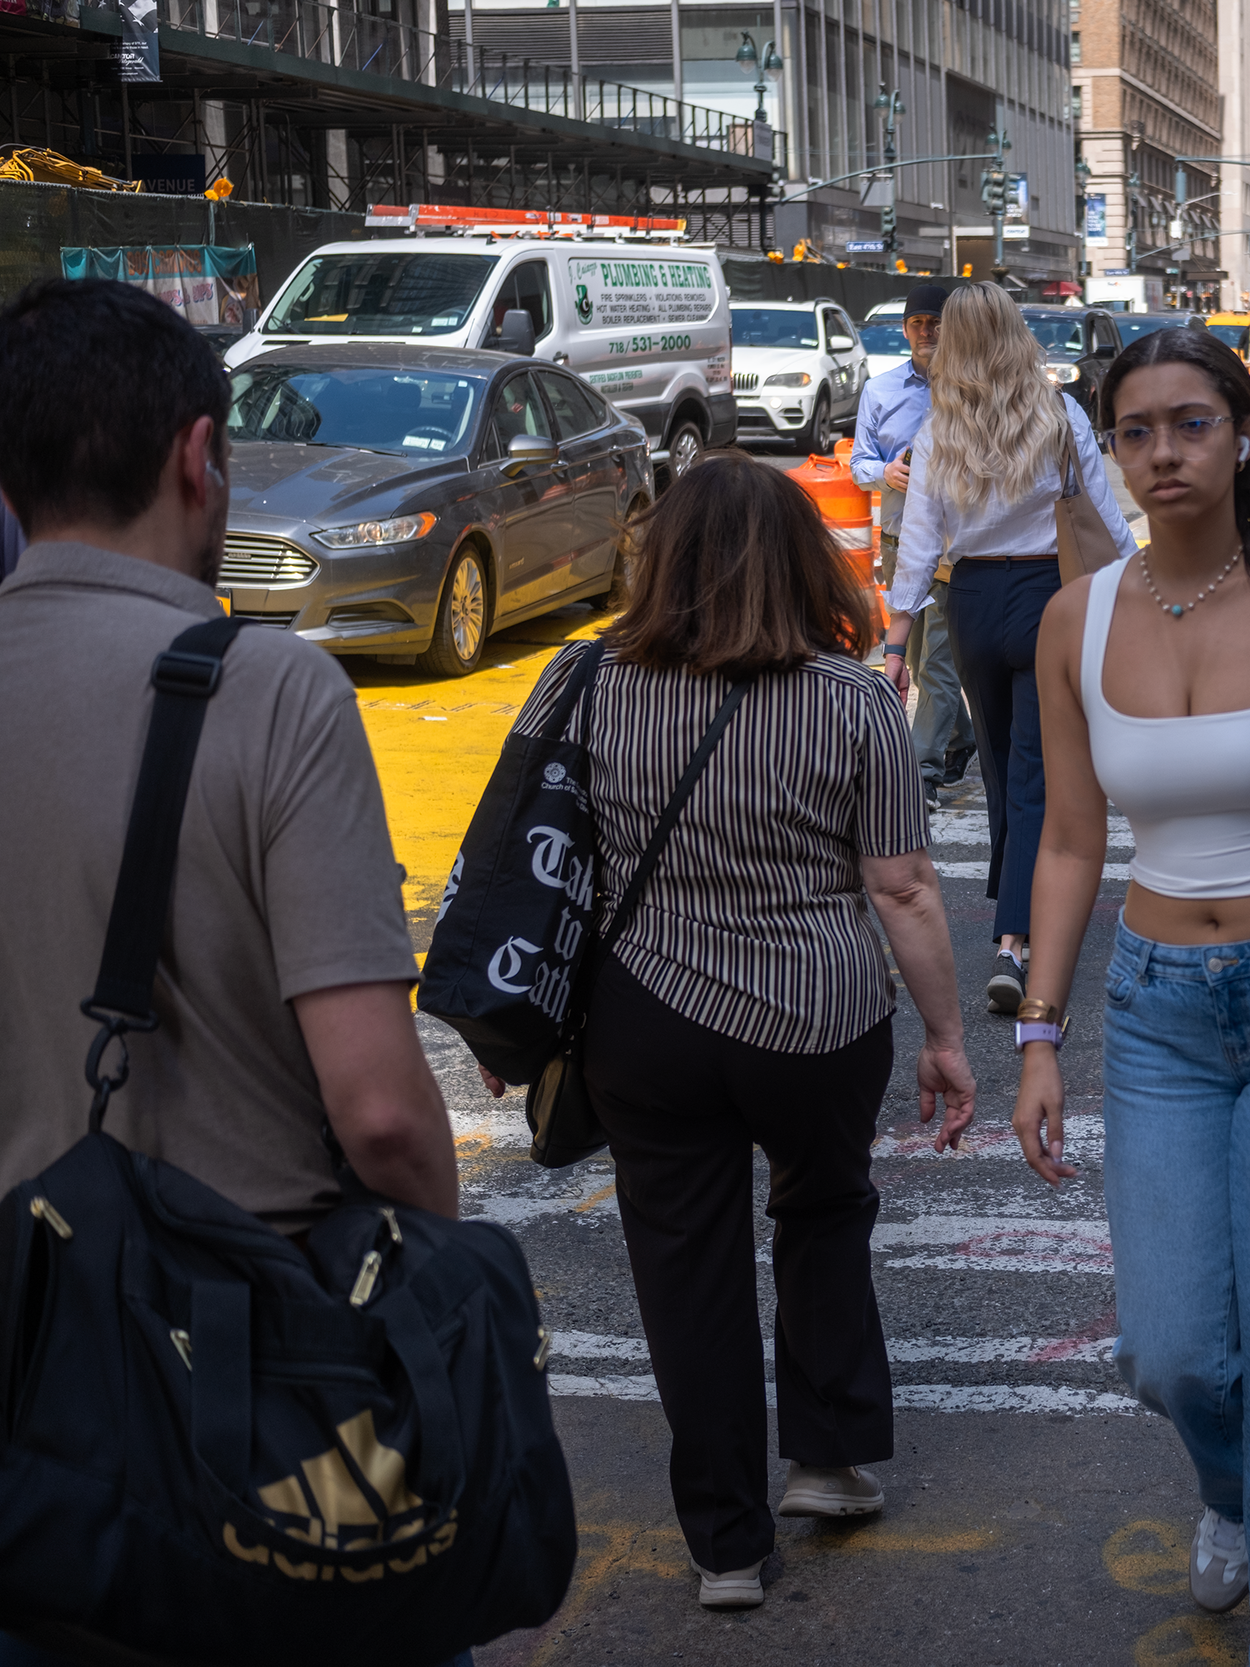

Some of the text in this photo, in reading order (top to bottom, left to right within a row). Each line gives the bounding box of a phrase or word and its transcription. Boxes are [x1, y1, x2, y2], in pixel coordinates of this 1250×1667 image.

[600, 263, 712, 289] PLUMBING & HEATING
[601, 293, 706, 302] FIRE SPRINKLERS VIOLATIONS REMOVED
[597, 304, 712, 313] HOT WATER HEATING ALL PLUMBING REPAIRS
[602, 315, 621, 324] BOILER
[623, 315, 660, 324] REPLACEMENT
[668, 314, 685, 322] SEWER
[541, 782, 563, 790] Church
[554, 906, 583, 961] to
